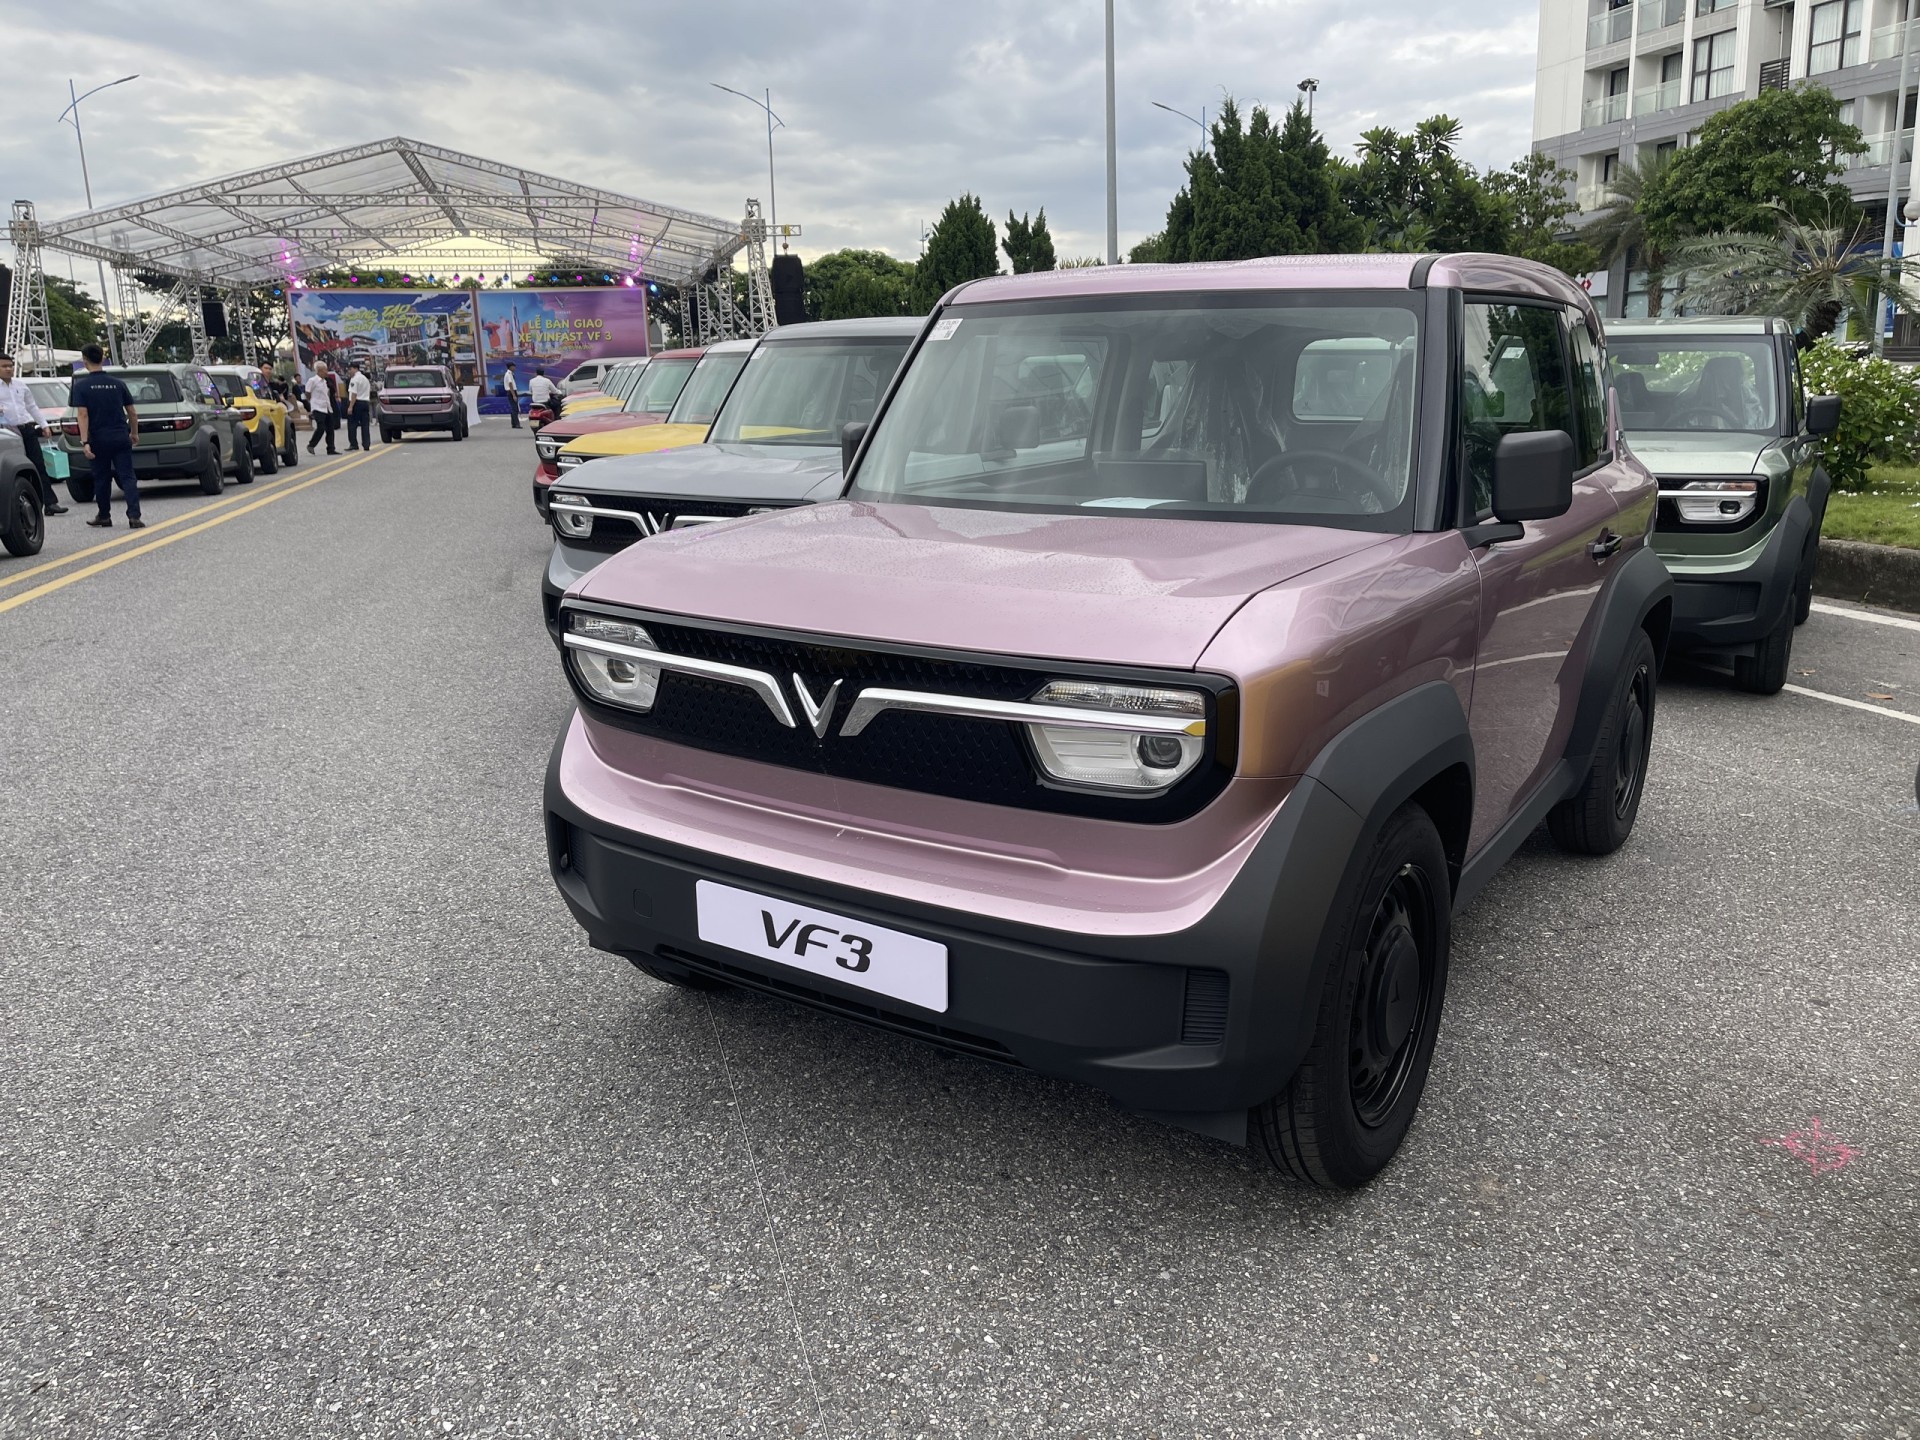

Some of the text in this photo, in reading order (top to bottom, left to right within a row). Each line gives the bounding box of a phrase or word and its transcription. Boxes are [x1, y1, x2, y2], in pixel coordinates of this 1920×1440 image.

[574, 318, 603, 329] GIAO
[518, 331, 612, 343] XE VINFAST VF 3
[761, 909, 873, 973] VF3
